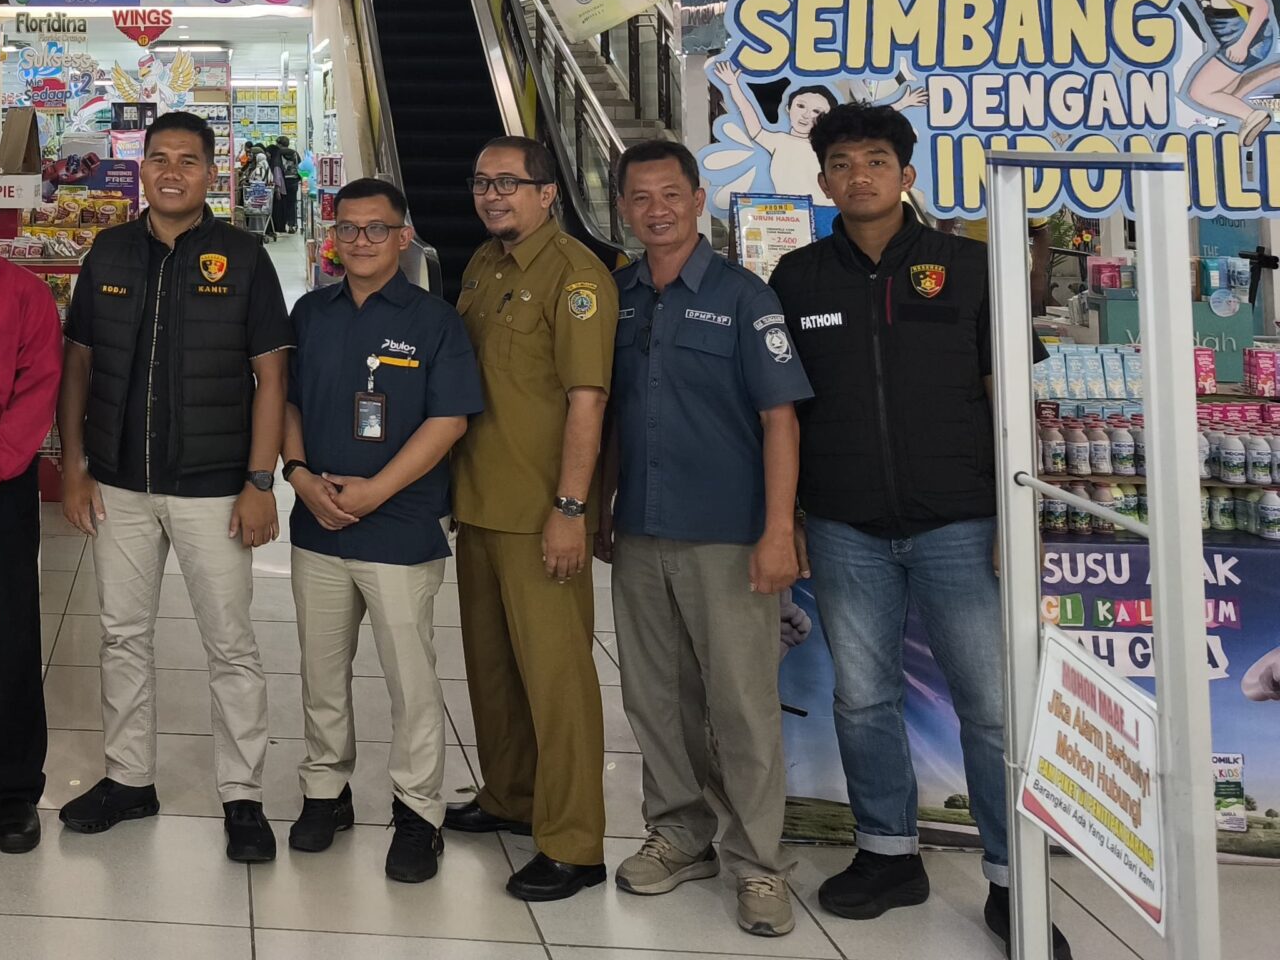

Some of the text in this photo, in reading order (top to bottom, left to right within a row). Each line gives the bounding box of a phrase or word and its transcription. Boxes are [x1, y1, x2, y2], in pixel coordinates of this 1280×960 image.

[15, 12, 87, 33] Floridina
[112, 9, 173, 26] WINGS
[25, 78, 43, 88] Mie
[24, 89, 73, 104] Sedaap
[927, 73, 1169, 130] DENGAN
[197, 285, 228, 294] KANIT
[800, 312, 843, 330] FATHONI
[1042, 551, 1130, 585] SUSU
[1072, 705, 1104, 753] Alarm
[1055, 729, 1142, 829] Mohon Hubungi
[1032, 779, 1072, 816] Barangkali
[1071, 809, 1087, 829] Ada
[1087, 820, 1105, 848] Yang
[1105, 837, 1123, 859] Lalai
